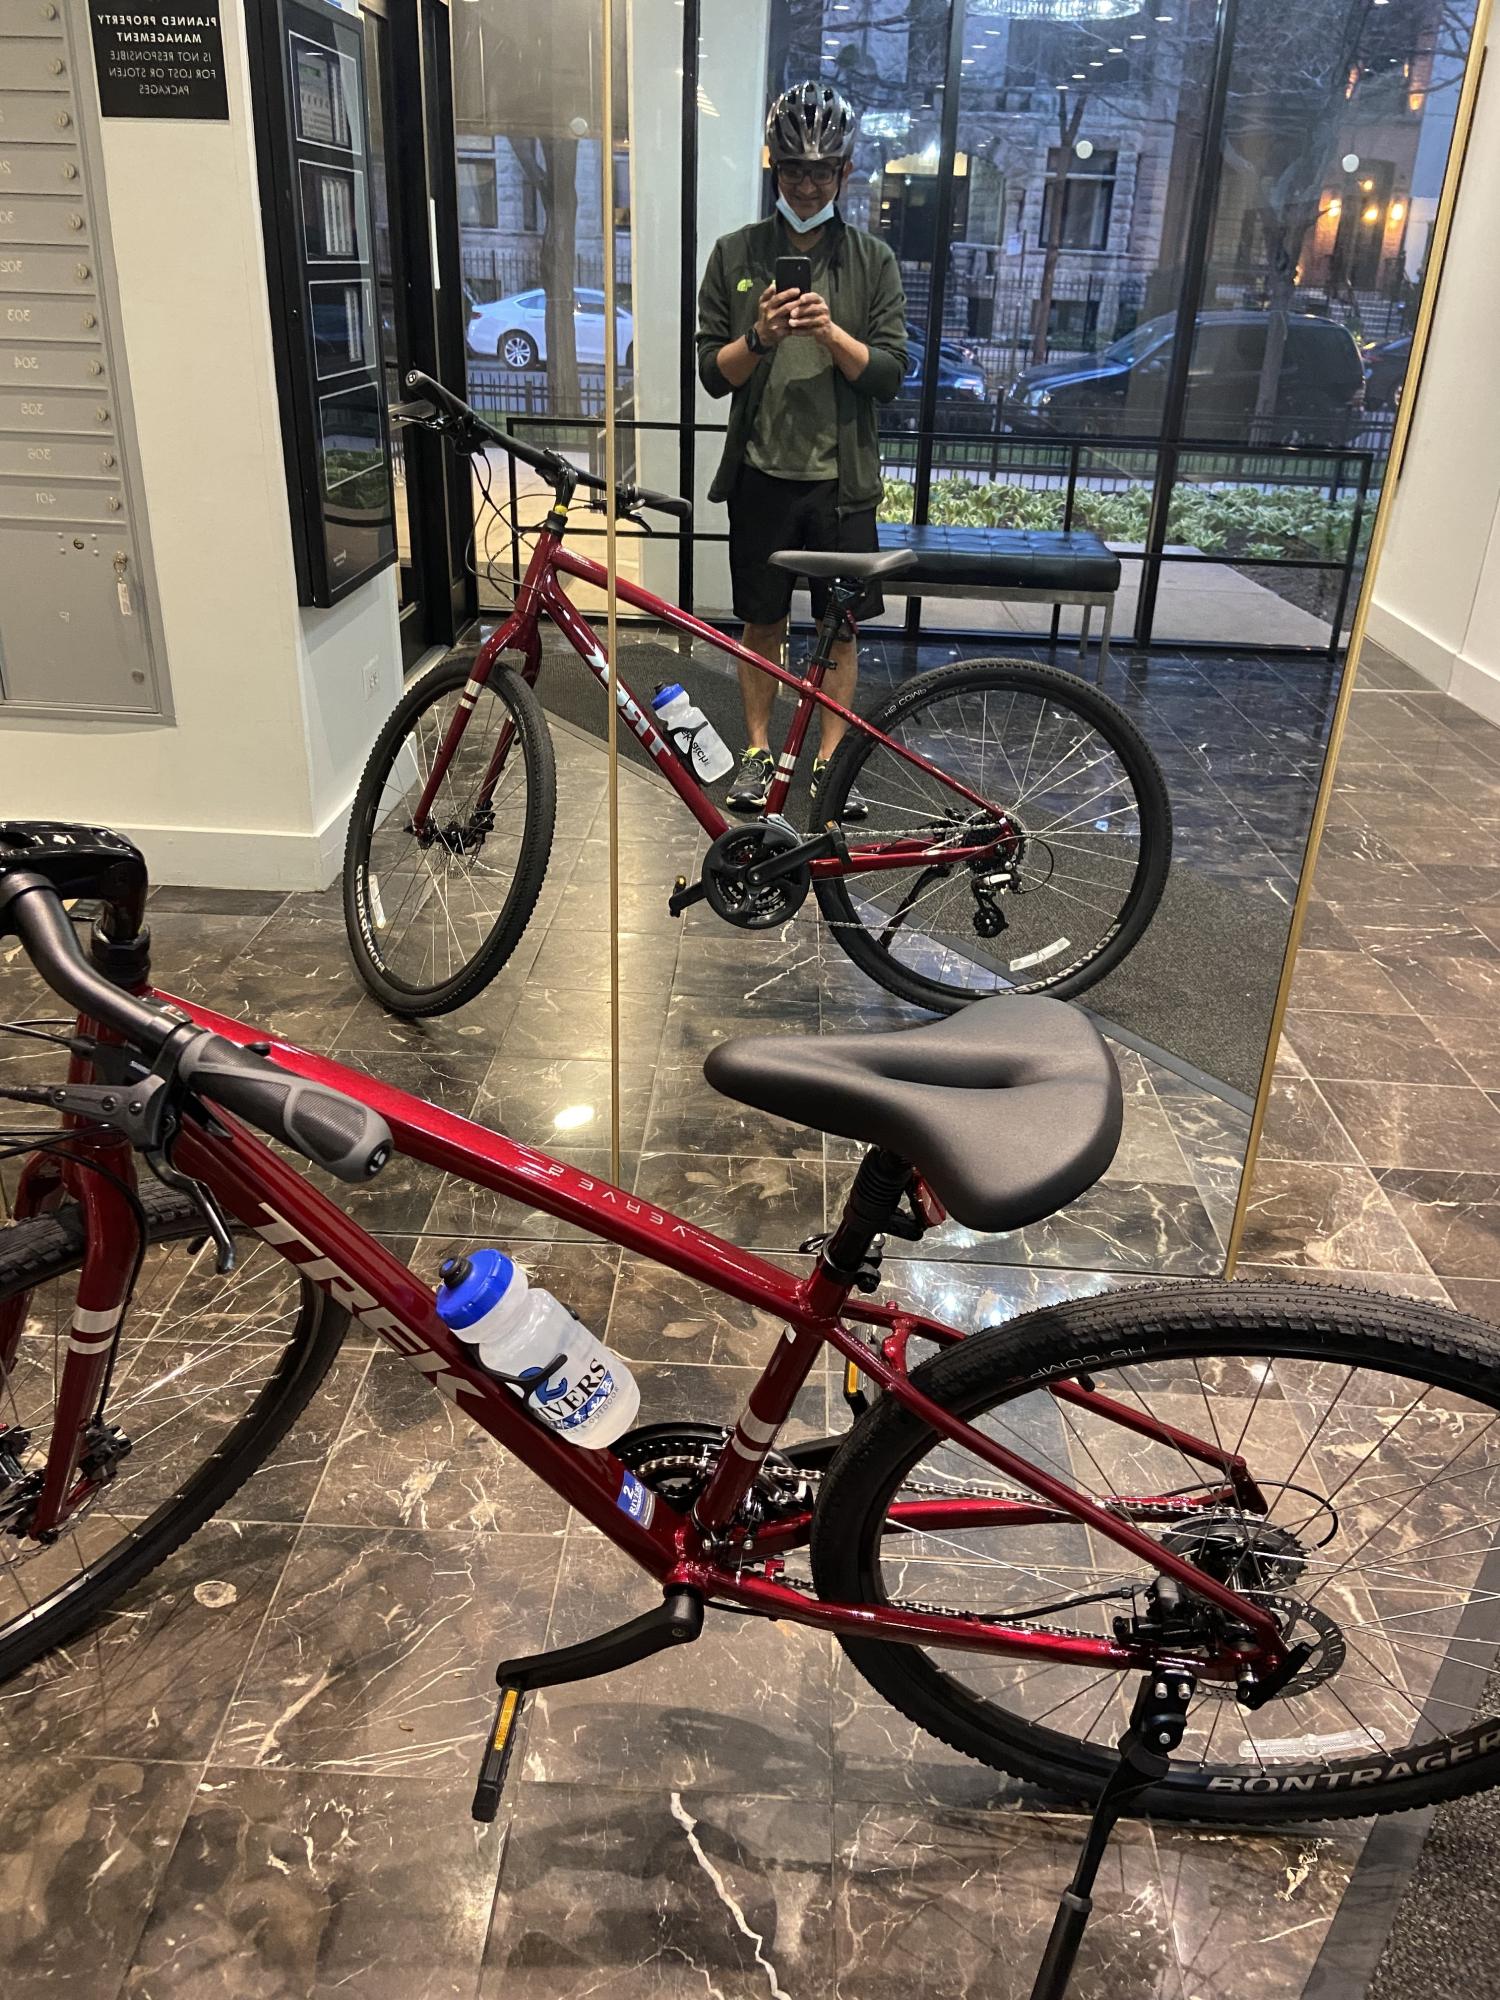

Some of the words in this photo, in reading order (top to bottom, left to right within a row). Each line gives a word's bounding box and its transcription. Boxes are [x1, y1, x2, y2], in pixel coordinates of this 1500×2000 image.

[578, 1177, 687, 1238] VERVE
[253, 1202, 487, 1404] TREK
[539, 1358, 606, 1420] IVERS
[1030, 1354, 1101, 1380] COMP
[1206, 1729, 1500, 1794] BONTRAGER
